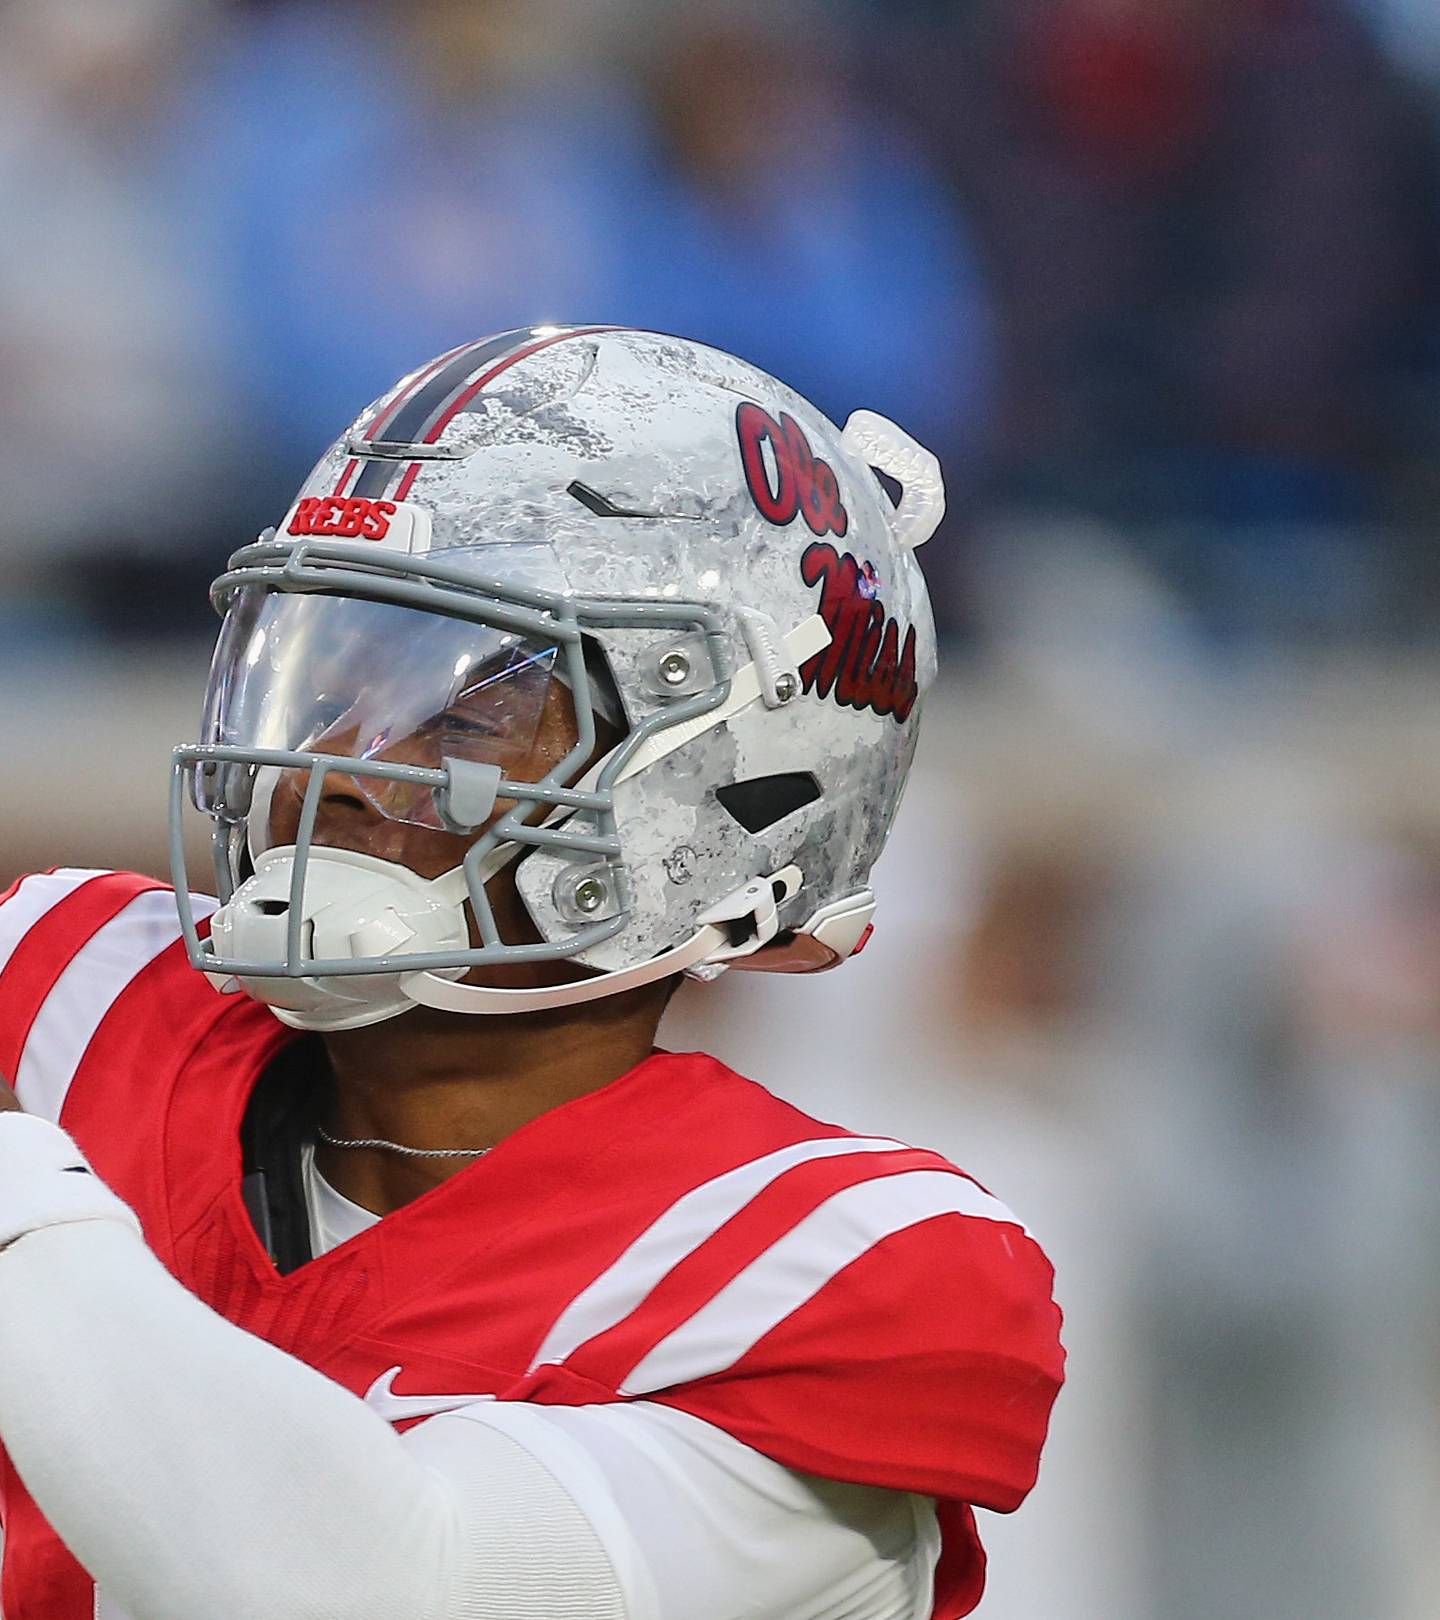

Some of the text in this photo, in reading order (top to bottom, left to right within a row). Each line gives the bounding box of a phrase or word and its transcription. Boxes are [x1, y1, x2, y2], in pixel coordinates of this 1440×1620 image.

[287, 496, 397, 541] REBS
[736, 401, 847, 537] Ole
[800, 542, 918, 724] Miss
